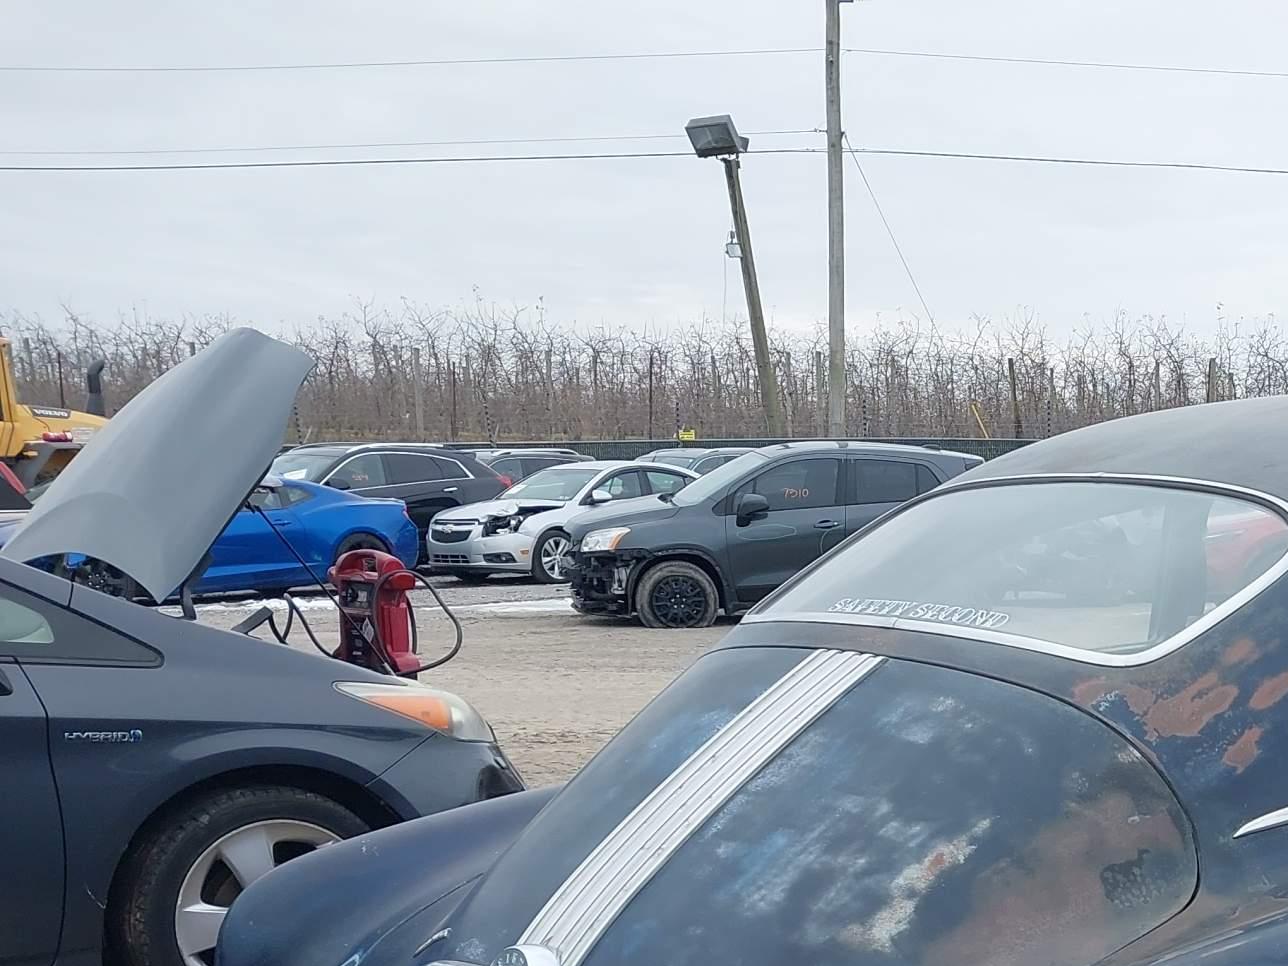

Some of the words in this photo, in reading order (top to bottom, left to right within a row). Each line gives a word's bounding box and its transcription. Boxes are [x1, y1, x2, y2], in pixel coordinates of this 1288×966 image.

[828, 599, 916, 616] SAFETY
[909, 603, 1009, 628] SECOND
[64, 731, 130, 742] HYBRID
